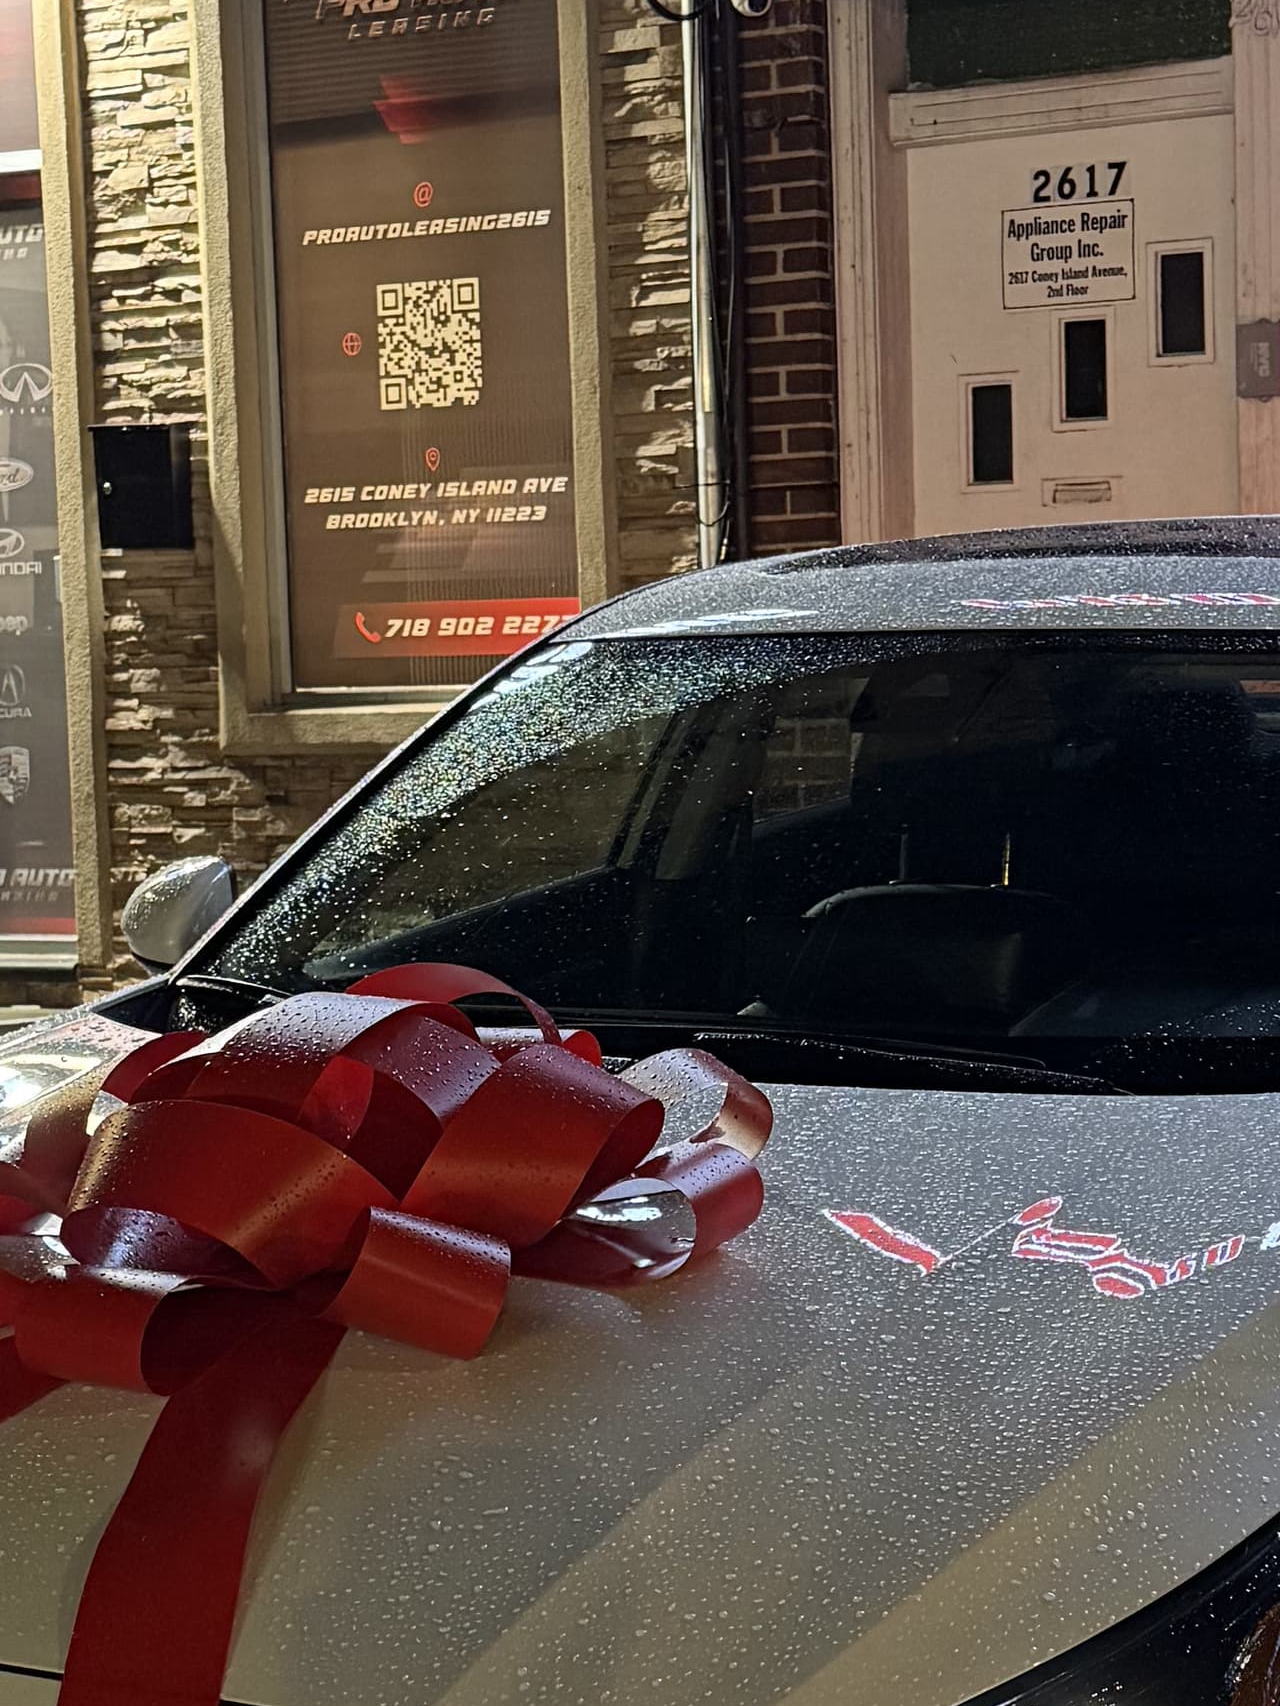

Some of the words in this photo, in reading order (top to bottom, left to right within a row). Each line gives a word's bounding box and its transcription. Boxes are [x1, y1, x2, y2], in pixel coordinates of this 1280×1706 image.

[348, 7, 495, 41] LEASING
[1032, 161, 1127, 203] 2617
[302, 209, 551, 246] PROAUTOLEASING2615
[1008, 216, 1076, 241] Appliance
[1081, 209, 1128, 234] Repair
[1031, 243, 1073, 263] Group
[1078, 239, 1104, 259] Inc.
[1008, 271, 1029, 285] 2617
[1032, 269, 1059, 284] Coney
[1061, 266, 1089, 281] Island
[1066, 283, 1089, 296] Floor
[304, 486, 355, 504] 2615
[359, 483, 431, 503] CONEY
[436, 479, 517, 499] ISLAND
[522, 476, 568, 495] AVE
[325, 511, 444, 530] BROOKLYN,
[451, 508, 481, 526] NY
[486, 505, 547, 524] 11223
[384, 617, 429, 637] 718
[438, 616, 493, 636] 902
[10, 869, 76, 886] AUTO
